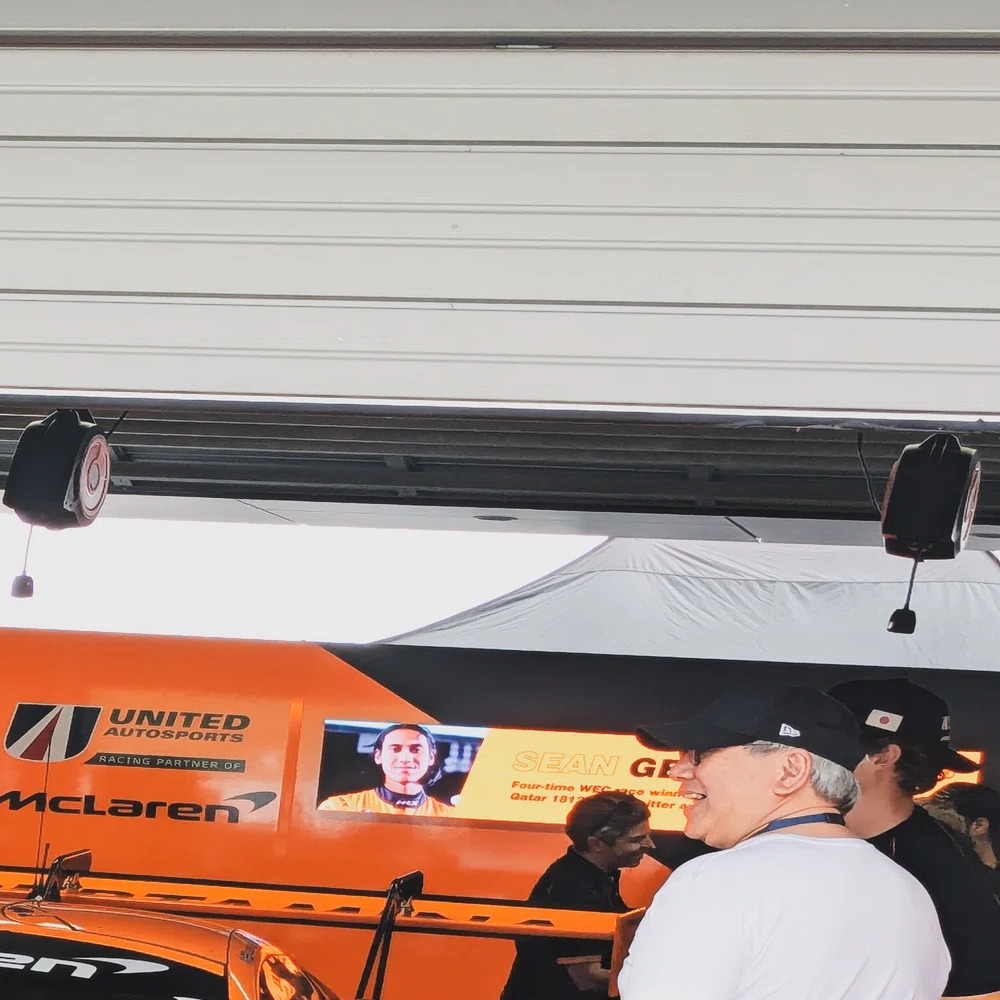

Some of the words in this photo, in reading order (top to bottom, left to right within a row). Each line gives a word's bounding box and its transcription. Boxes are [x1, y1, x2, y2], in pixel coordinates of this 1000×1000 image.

[108, 708, 251, 731] UNITED
[103, 728, 244, 743] AUTOSPORTS
[98, 754, 151, 766] RACING
[156, 758, 219, 770] PARTNER
[224, 761, 241, 770] OF
[511, 750, 620, 776] SEAN
[629, 757, 681, 778] GE
[511, 780, 575, 792] Four-time
[510, 792, 548, 802] Qatar
